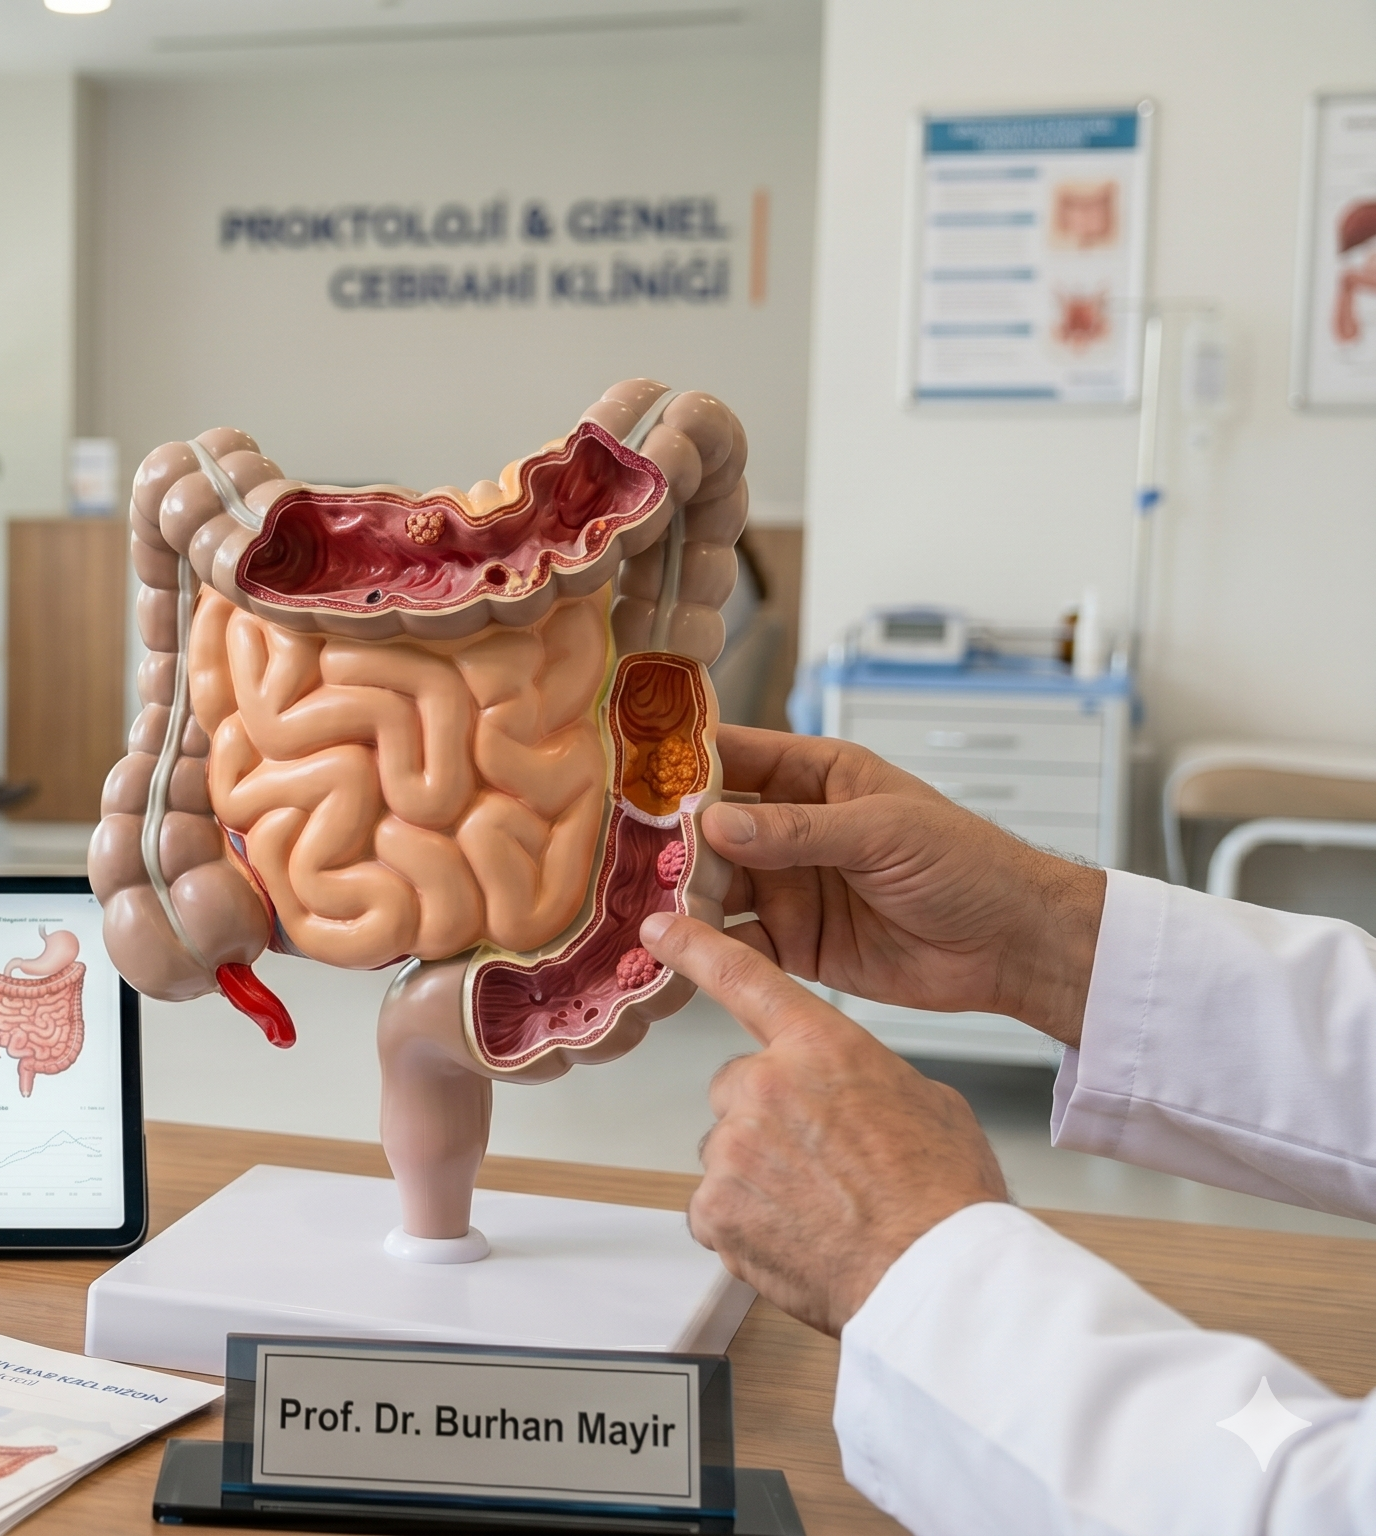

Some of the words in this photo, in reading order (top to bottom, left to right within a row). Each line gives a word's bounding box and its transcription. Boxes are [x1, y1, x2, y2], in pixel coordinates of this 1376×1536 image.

[220, 194, 508, 251] PROKTOLOJİ
[523, 201, 553, 241] &
[567, 196, 728, 243] GENEL
[279, 1398, 361, 1433] Prof.
[374, 1401, 422, 1436] Dr.
[435, 1405, 565, 1443] Burhan
[577, 1411, 676, 1454] Mayir
